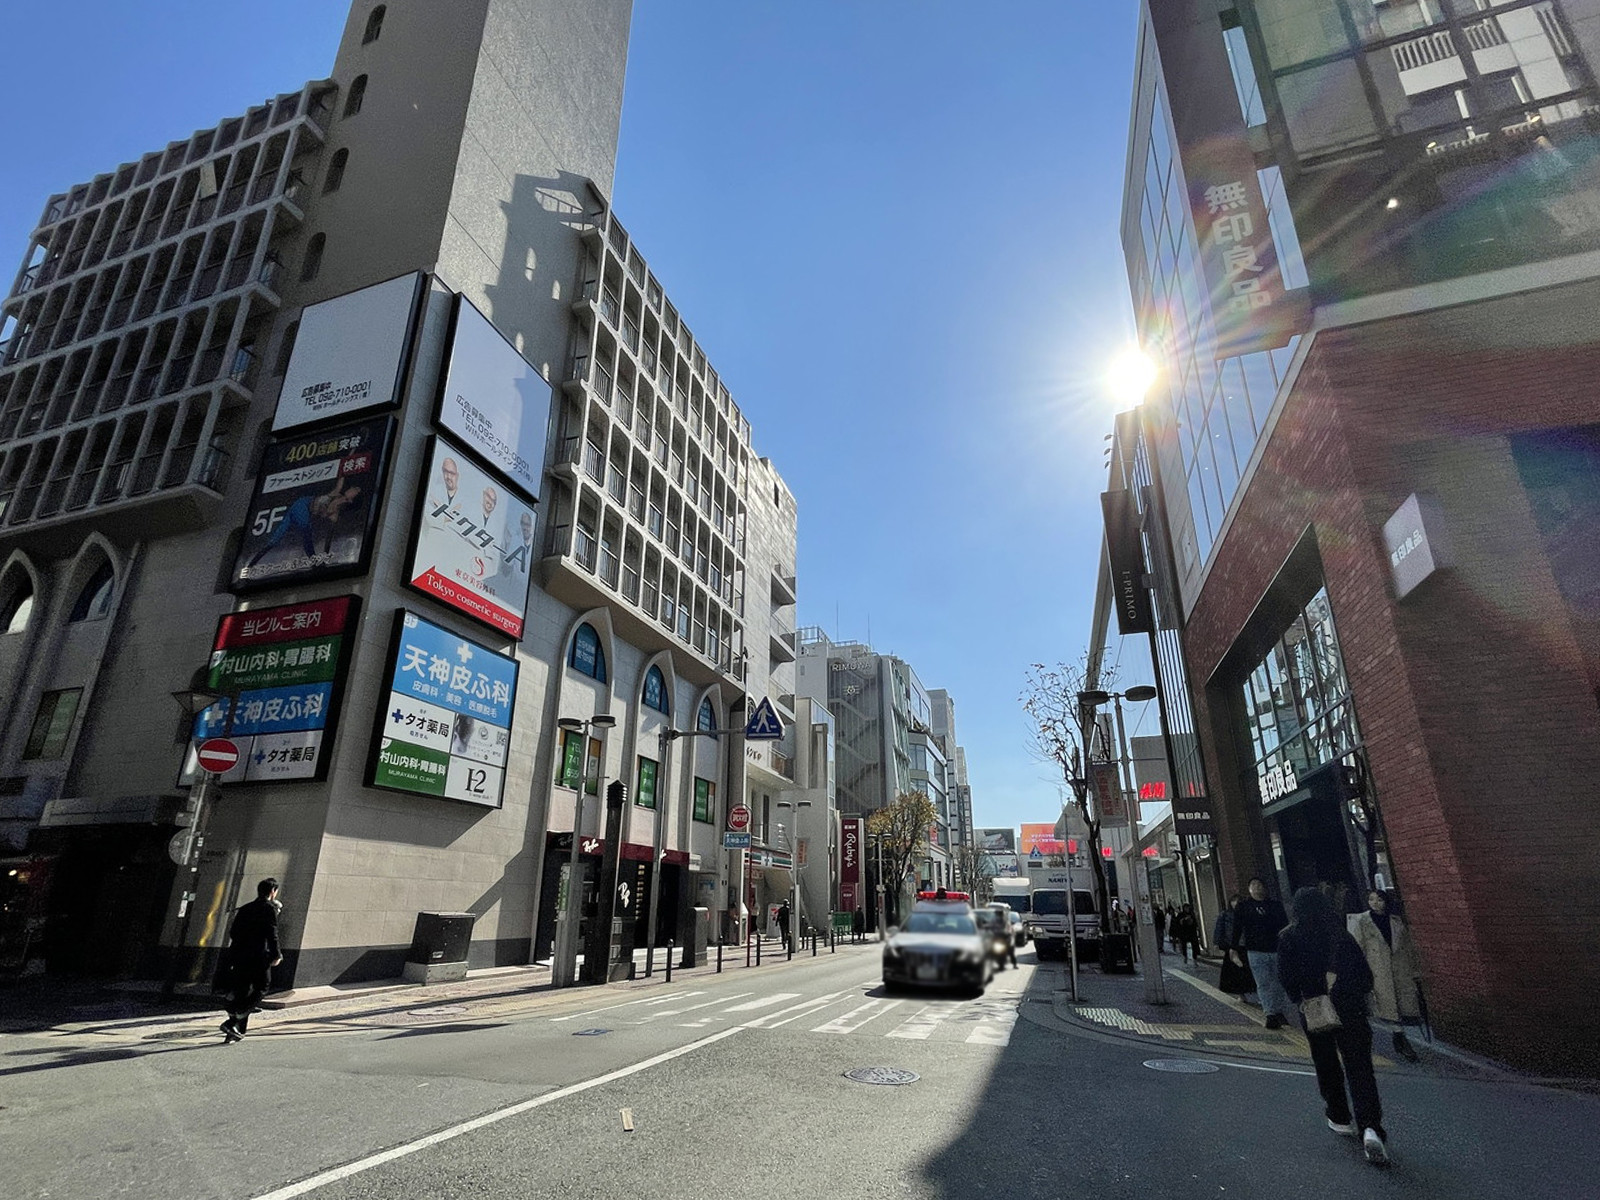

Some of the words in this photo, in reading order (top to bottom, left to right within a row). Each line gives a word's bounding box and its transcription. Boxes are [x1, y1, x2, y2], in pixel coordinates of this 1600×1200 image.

[1204, 181, 1271, 310] 無印良品
[305, 394, 317, 406] TEL
[318, 381, 371, 403] 092-710-0001
[461, 408, 476, 428] TEL
[478, 424, 530, 472] 092-710-0001
[343, 456, 367, 473] 検索
[252, 506, 287, 536] 5F
[431, 503, 526, 573] ドクターA
[426, 573, 455, 597] Tokyo
[456, 593, 492, 617] cosmetic
[492, 612, 521, 634] surgery
[1121, 570, 1137, 619] I-PRIMO
[241, 609, 322, 637] 当ビルご案内
[401, 643, 510, 708] 天神皮ふ科
[405, 713, 450, 738] タオ薬局
[267, 746, 316, 764] タオ薬局
[1257, 759, 1298, 805] 無印良品
